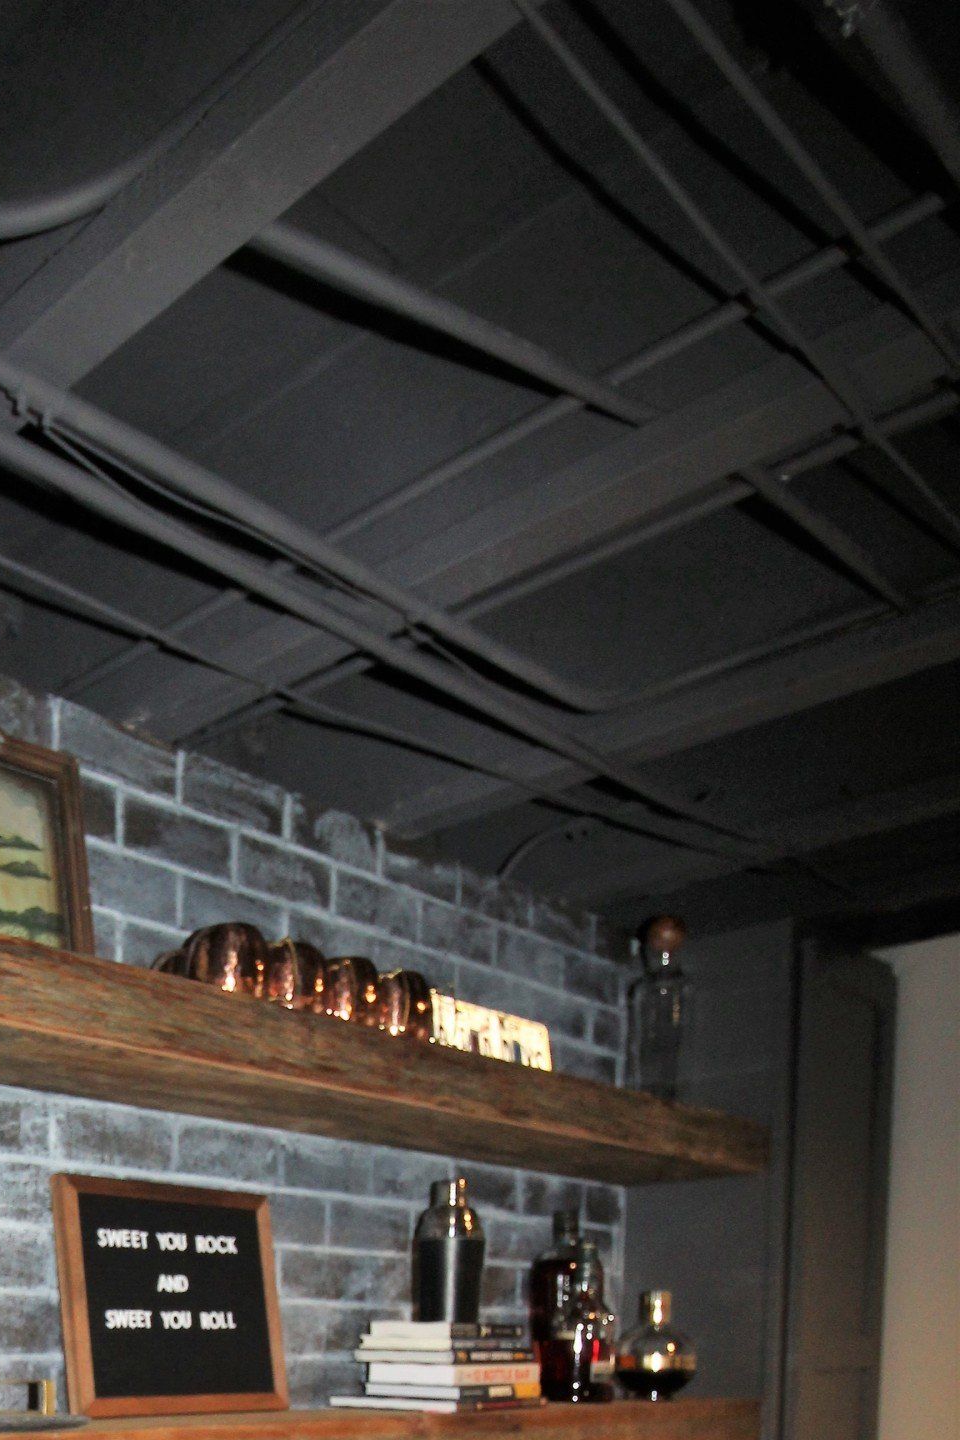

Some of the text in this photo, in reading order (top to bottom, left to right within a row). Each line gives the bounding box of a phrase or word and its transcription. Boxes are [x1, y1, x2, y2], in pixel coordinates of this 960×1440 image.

[96, 1228, 239, 1255] SWEET YOU ROCK
[156, 1273, 189, 1293] AND
[104, 1308, 237, 1330] SWEET YOU ROLL
